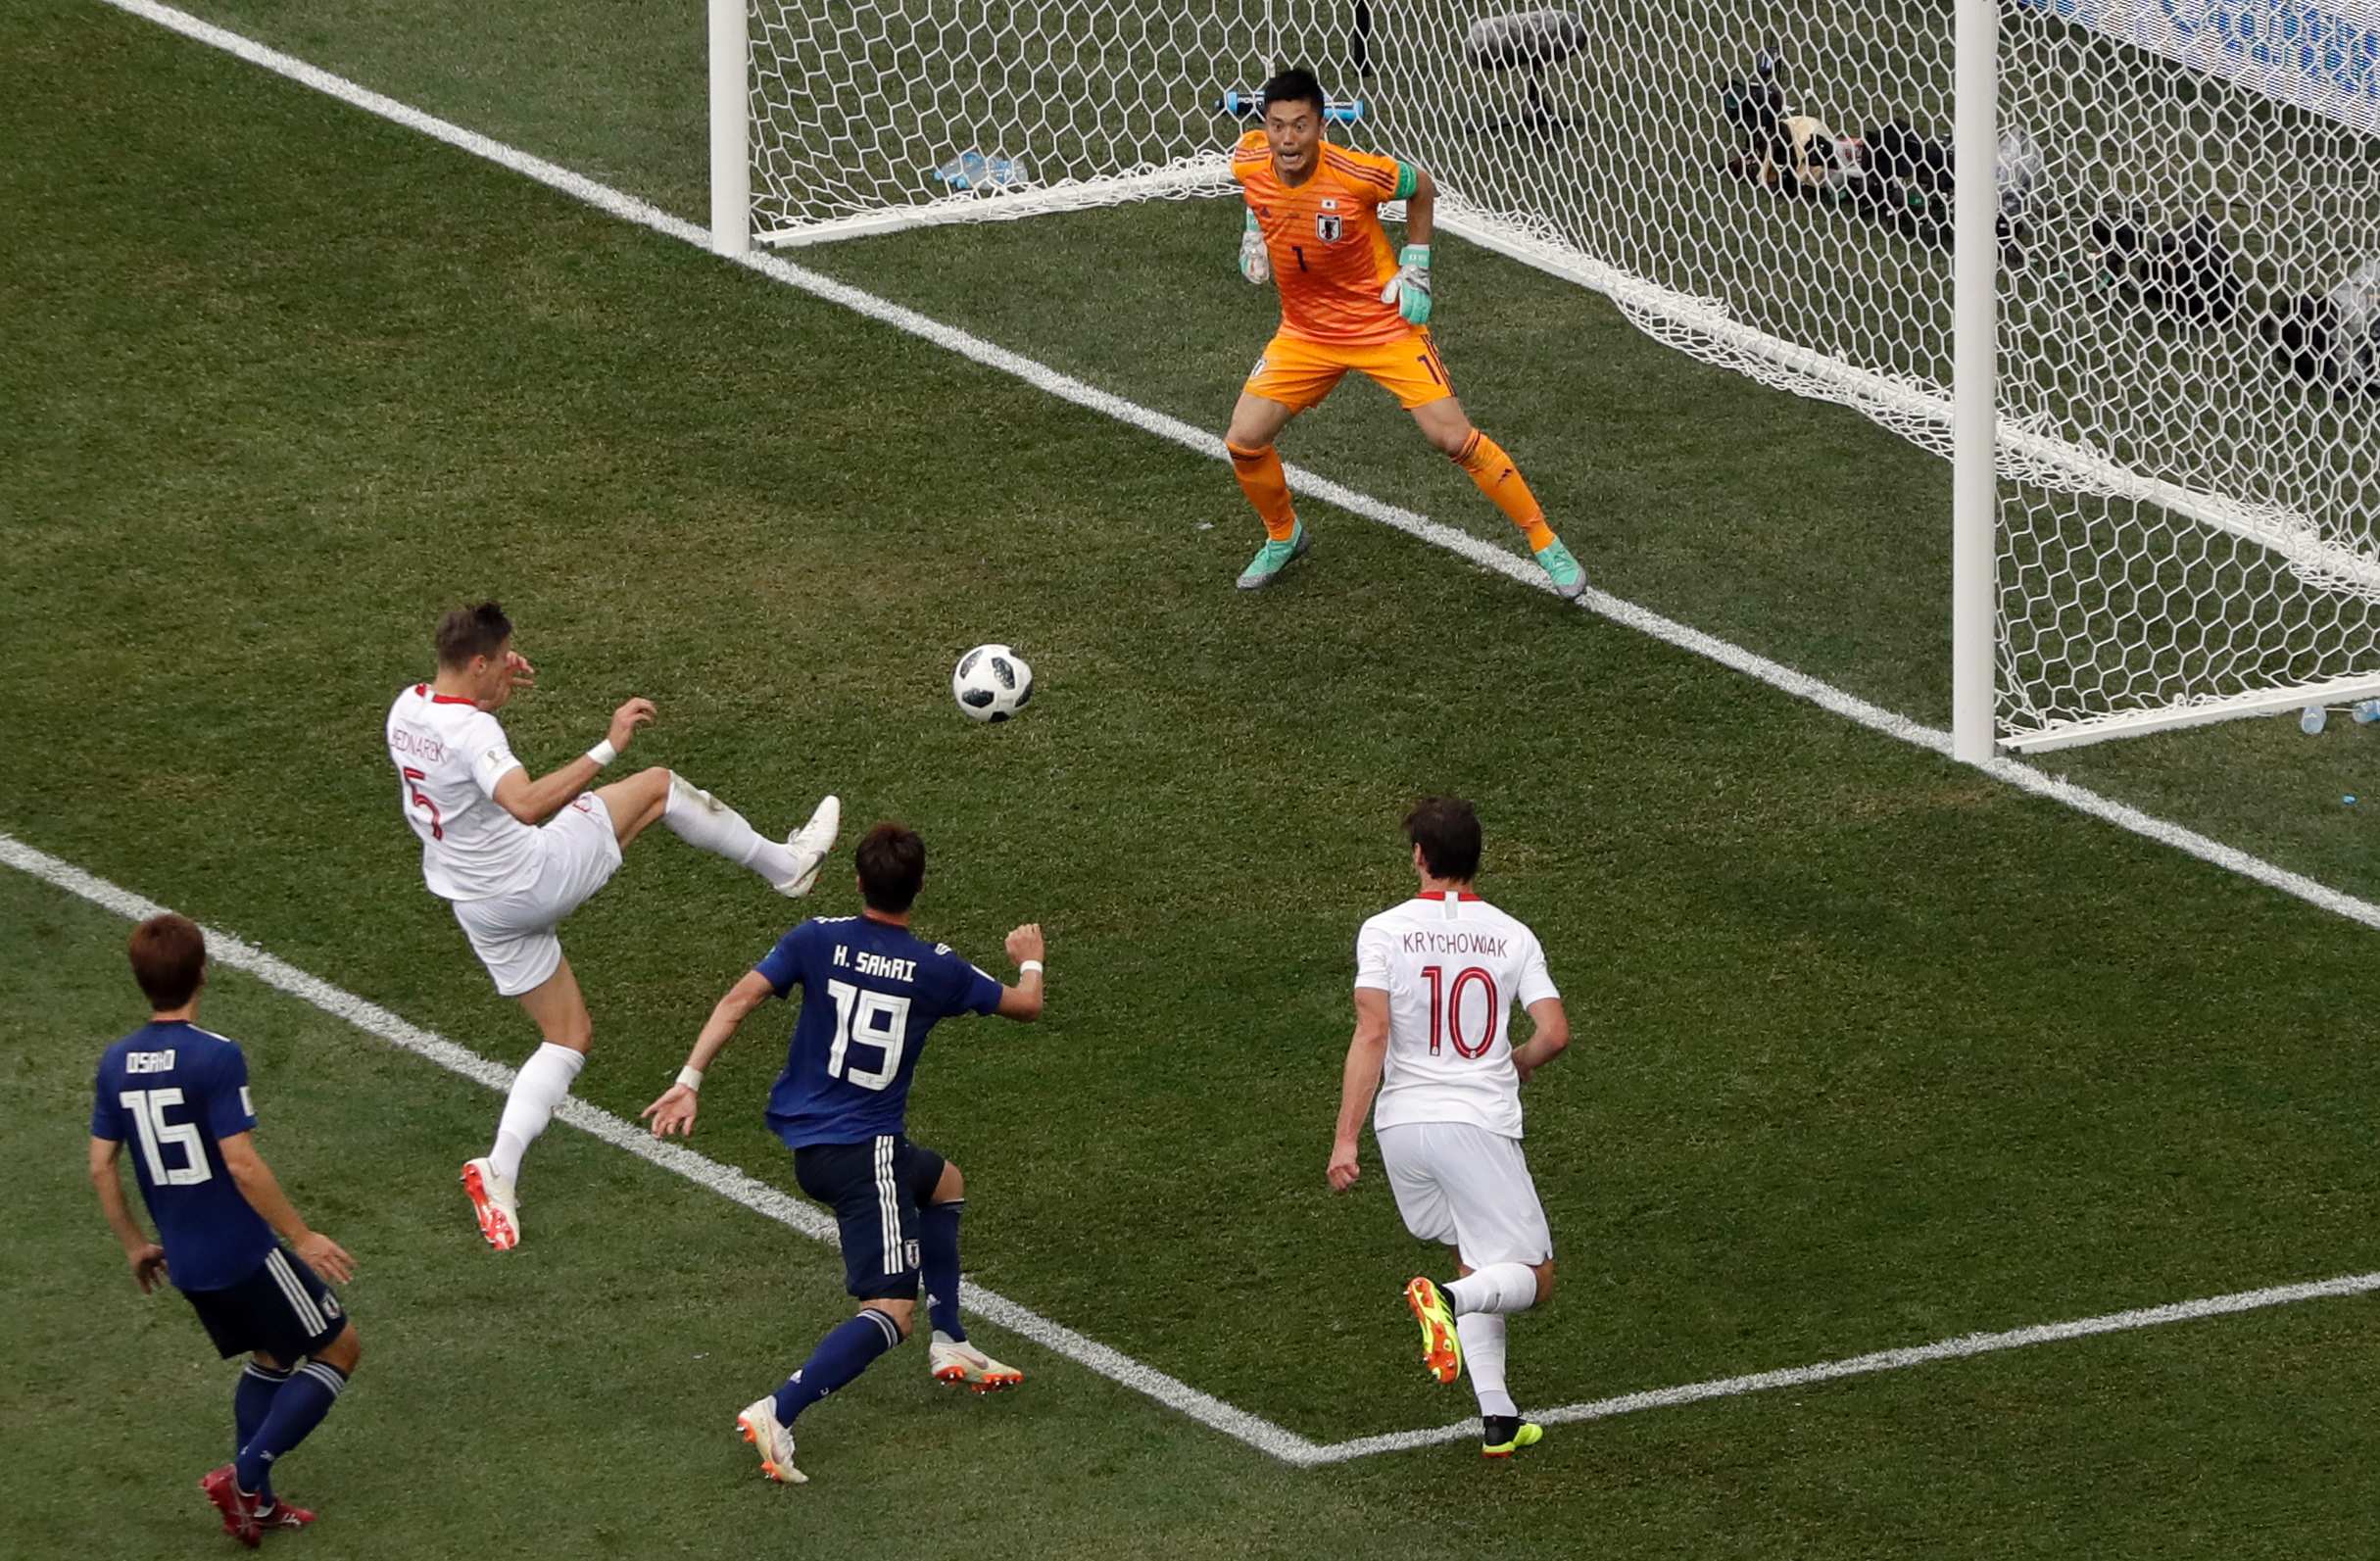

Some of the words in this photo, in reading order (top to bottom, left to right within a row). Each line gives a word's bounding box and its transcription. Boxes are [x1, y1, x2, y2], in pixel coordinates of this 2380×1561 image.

[1291, 246, 1308, 272] 1
[1417, 354, 1441, 386] 1
[403, 765, 443, 842] 5
[833, 945, 850, 967] H.
[854, 951, 917, 982] SAKAI
[1403, 932, 1508, 957] KRYCHOWIAK
[827, 978, 911, 1091] 19
[1421, 965, 1498, 1060] 10
[119, 1088, 213, 1186] 15
